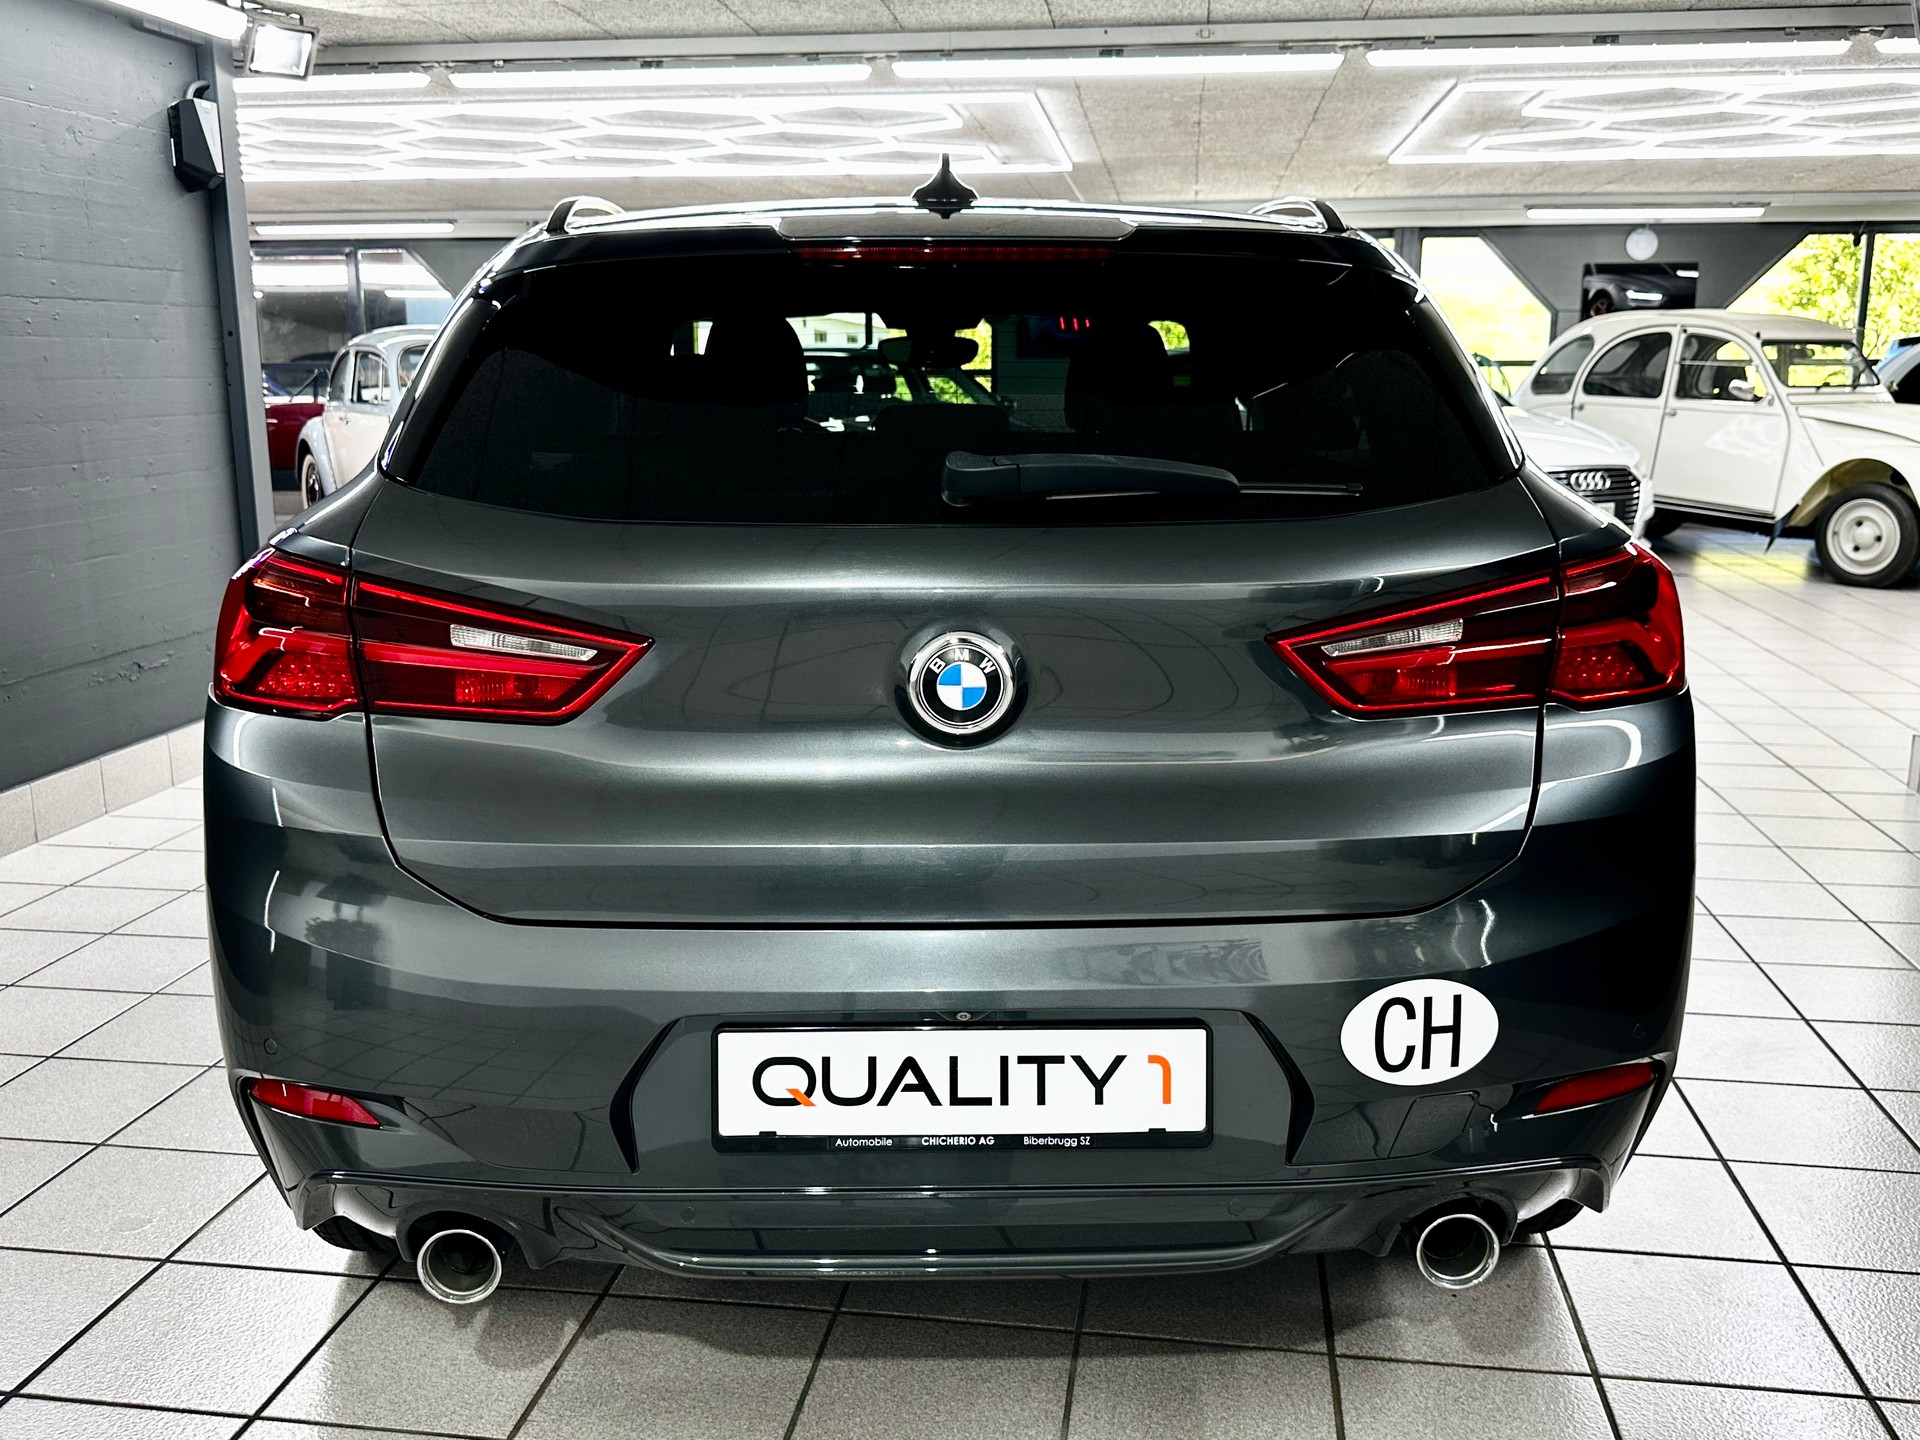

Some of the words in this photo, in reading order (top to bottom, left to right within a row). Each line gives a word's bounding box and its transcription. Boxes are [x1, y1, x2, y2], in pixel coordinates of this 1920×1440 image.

[928, 648, 997, 674] BMW
[1374, 993, 1462, 1073] CH
[752, 1055, 1128, 1107] QUALITY
[1147, 1054, 1172, 1105] 1
[835, 1137, 893, 1147] Automobile
[921, 1136, 977, 1146] CHICHERIO
[978, 1136, 995, 1145] AG
[1023, 1136, 1078, 1147] Biberbrugg
[1079, 1136, 1091, 1146] SZ
